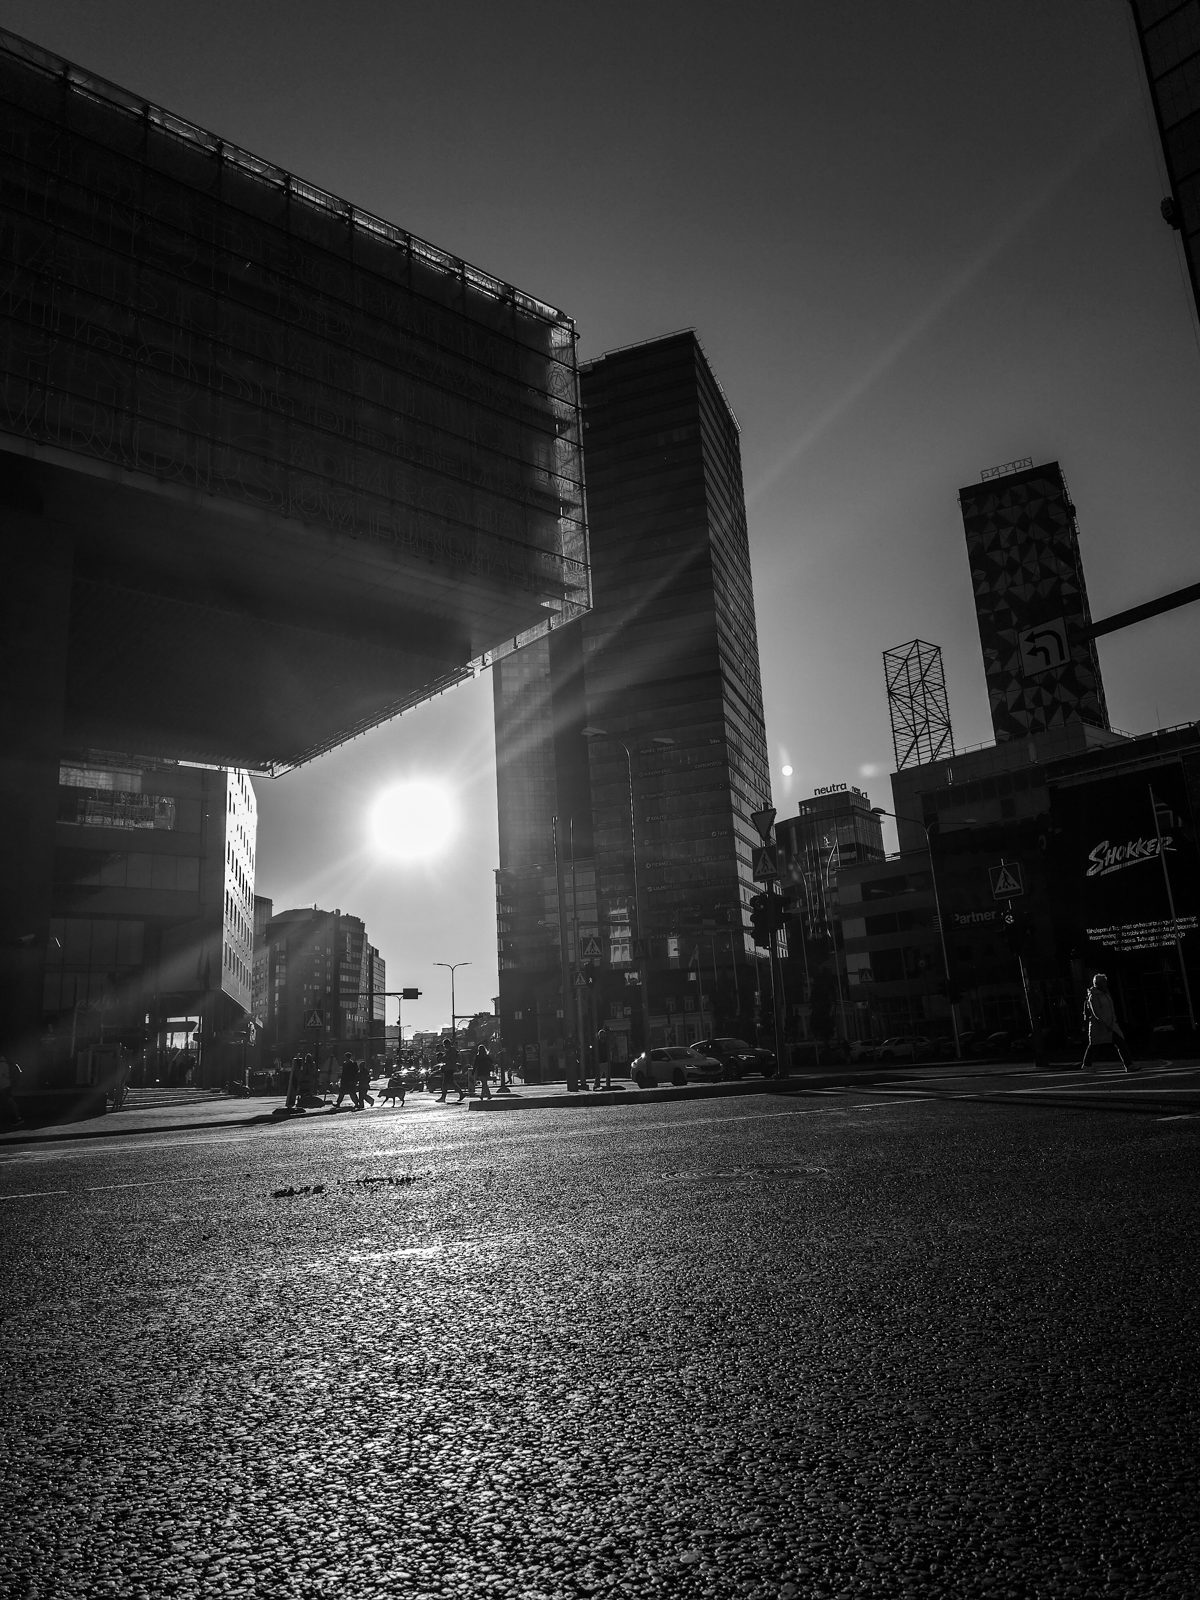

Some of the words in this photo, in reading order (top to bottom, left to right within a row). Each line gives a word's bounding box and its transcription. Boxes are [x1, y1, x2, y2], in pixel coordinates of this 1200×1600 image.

[813, 783, 847, 796] neutra
[1086, 836, 1177, 877] SHOKKER
[953, 911, 997, 925] Partner
